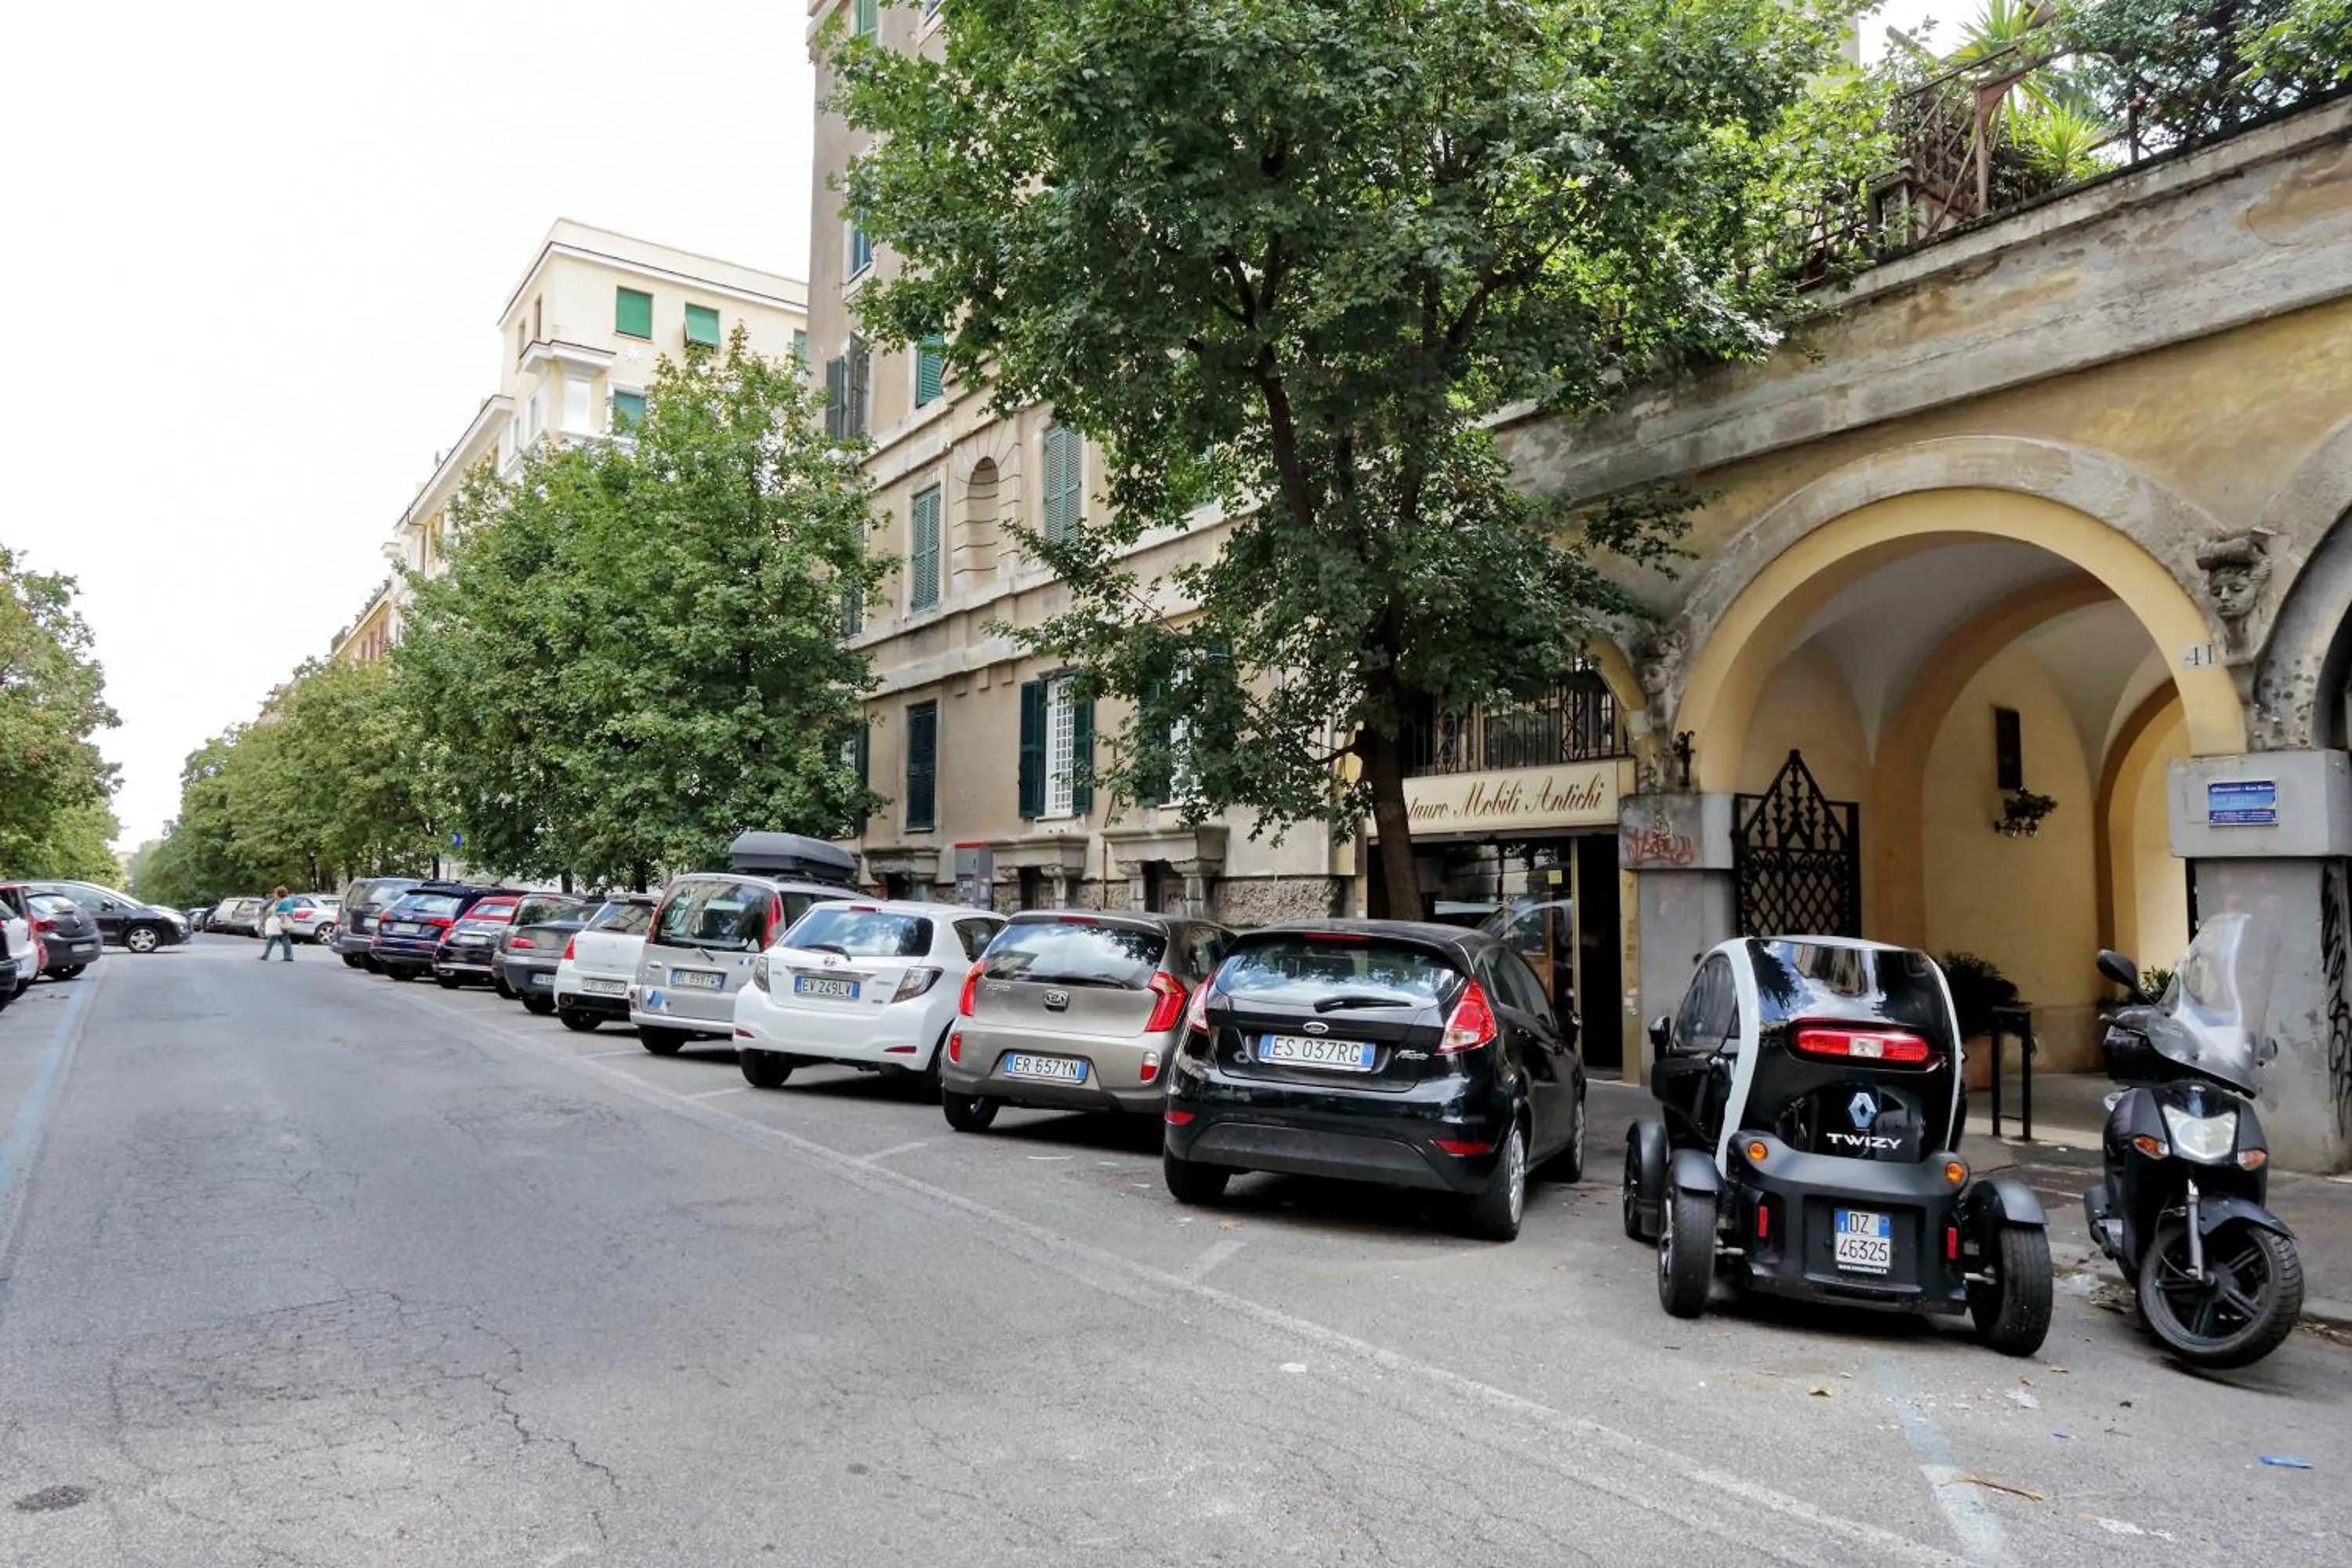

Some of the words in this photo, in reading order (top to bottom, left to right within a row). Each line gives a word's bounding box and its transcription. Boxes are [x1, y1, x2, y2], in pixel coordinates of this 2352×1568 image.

[2184, 644, 2214, 666] 41
[1407, 796, 1449, 820] tauro
[1454, 778, 1523, 818] Mobili
[1525, 771, 1605, 815] Antichi
[802, 977, 816, 992] EV
[818, 979, 852, 996] 249LV
[1272, 1036, 1296, 1057] ES
[1301, 1040, 1362, 1063] 037RG
[1014, 1056, 1032, 1072] ER
[1034, 1058, 1079, 1076] 657YN
[1825, 1131, 1903, 1150] TWIZY
[1849, 1213, 1870, 1235] DZ
[1838, 1237, 1888, 1262] 46325
